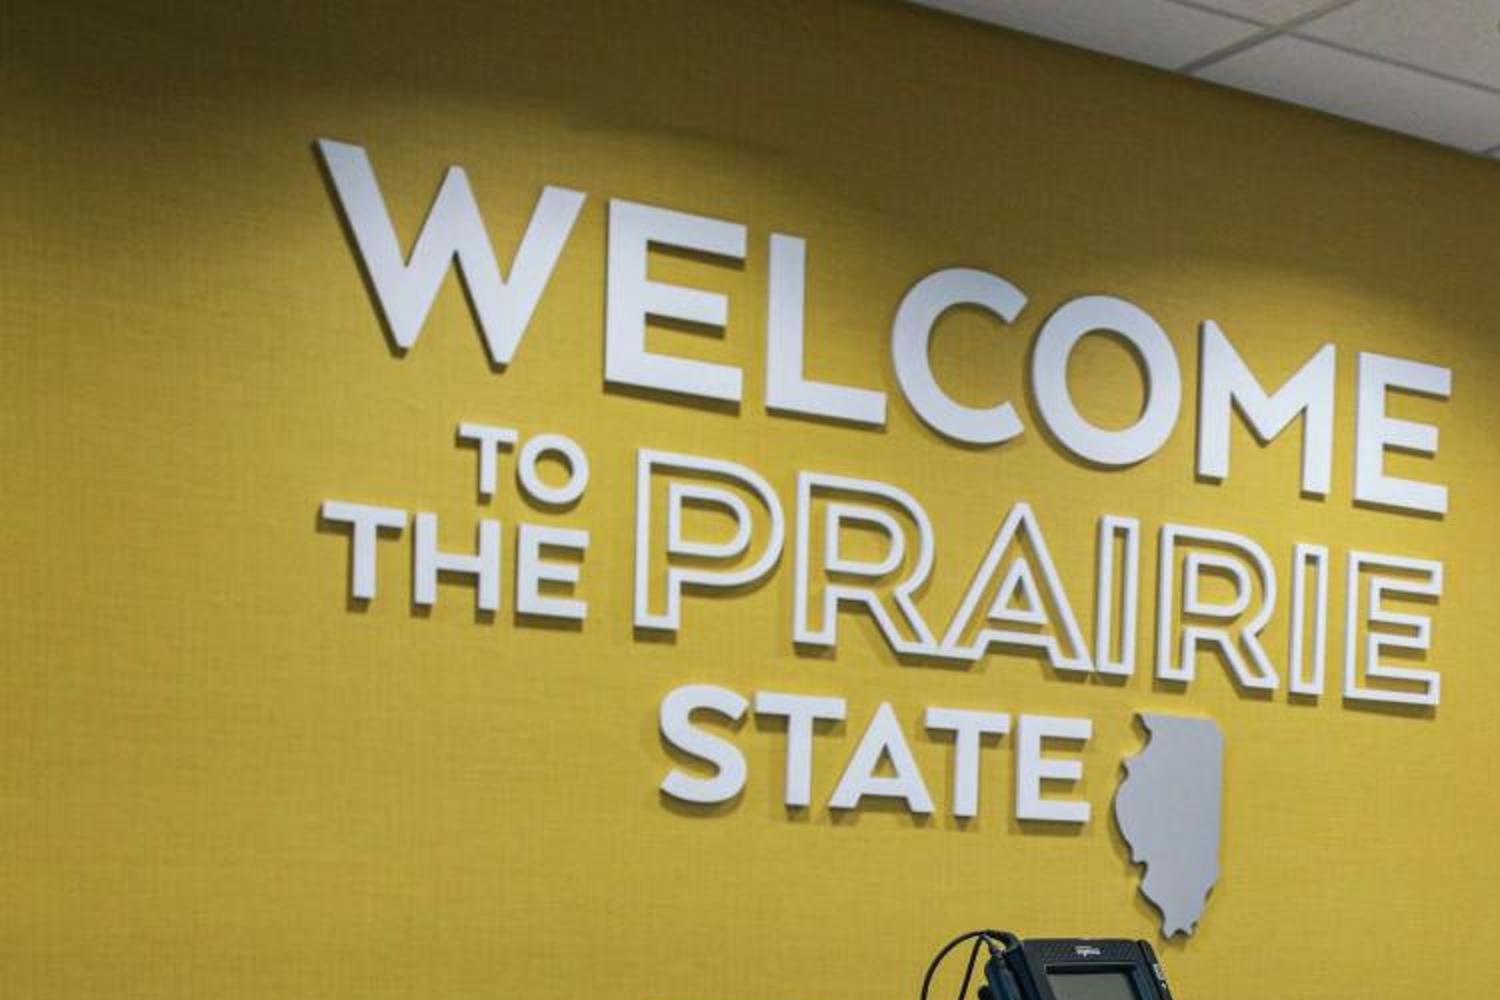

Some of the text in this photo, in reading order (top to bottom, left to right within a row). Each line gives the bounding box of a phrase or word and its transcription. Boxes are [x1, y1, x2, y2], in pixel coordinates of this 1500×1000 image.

[317, 138, 1452, 514] WELCOME
[458, 423, 590, 504] TO
[321, 448, 1443, 706] THE PRAIRIE
[659, 684, 1092, 823] STATE
